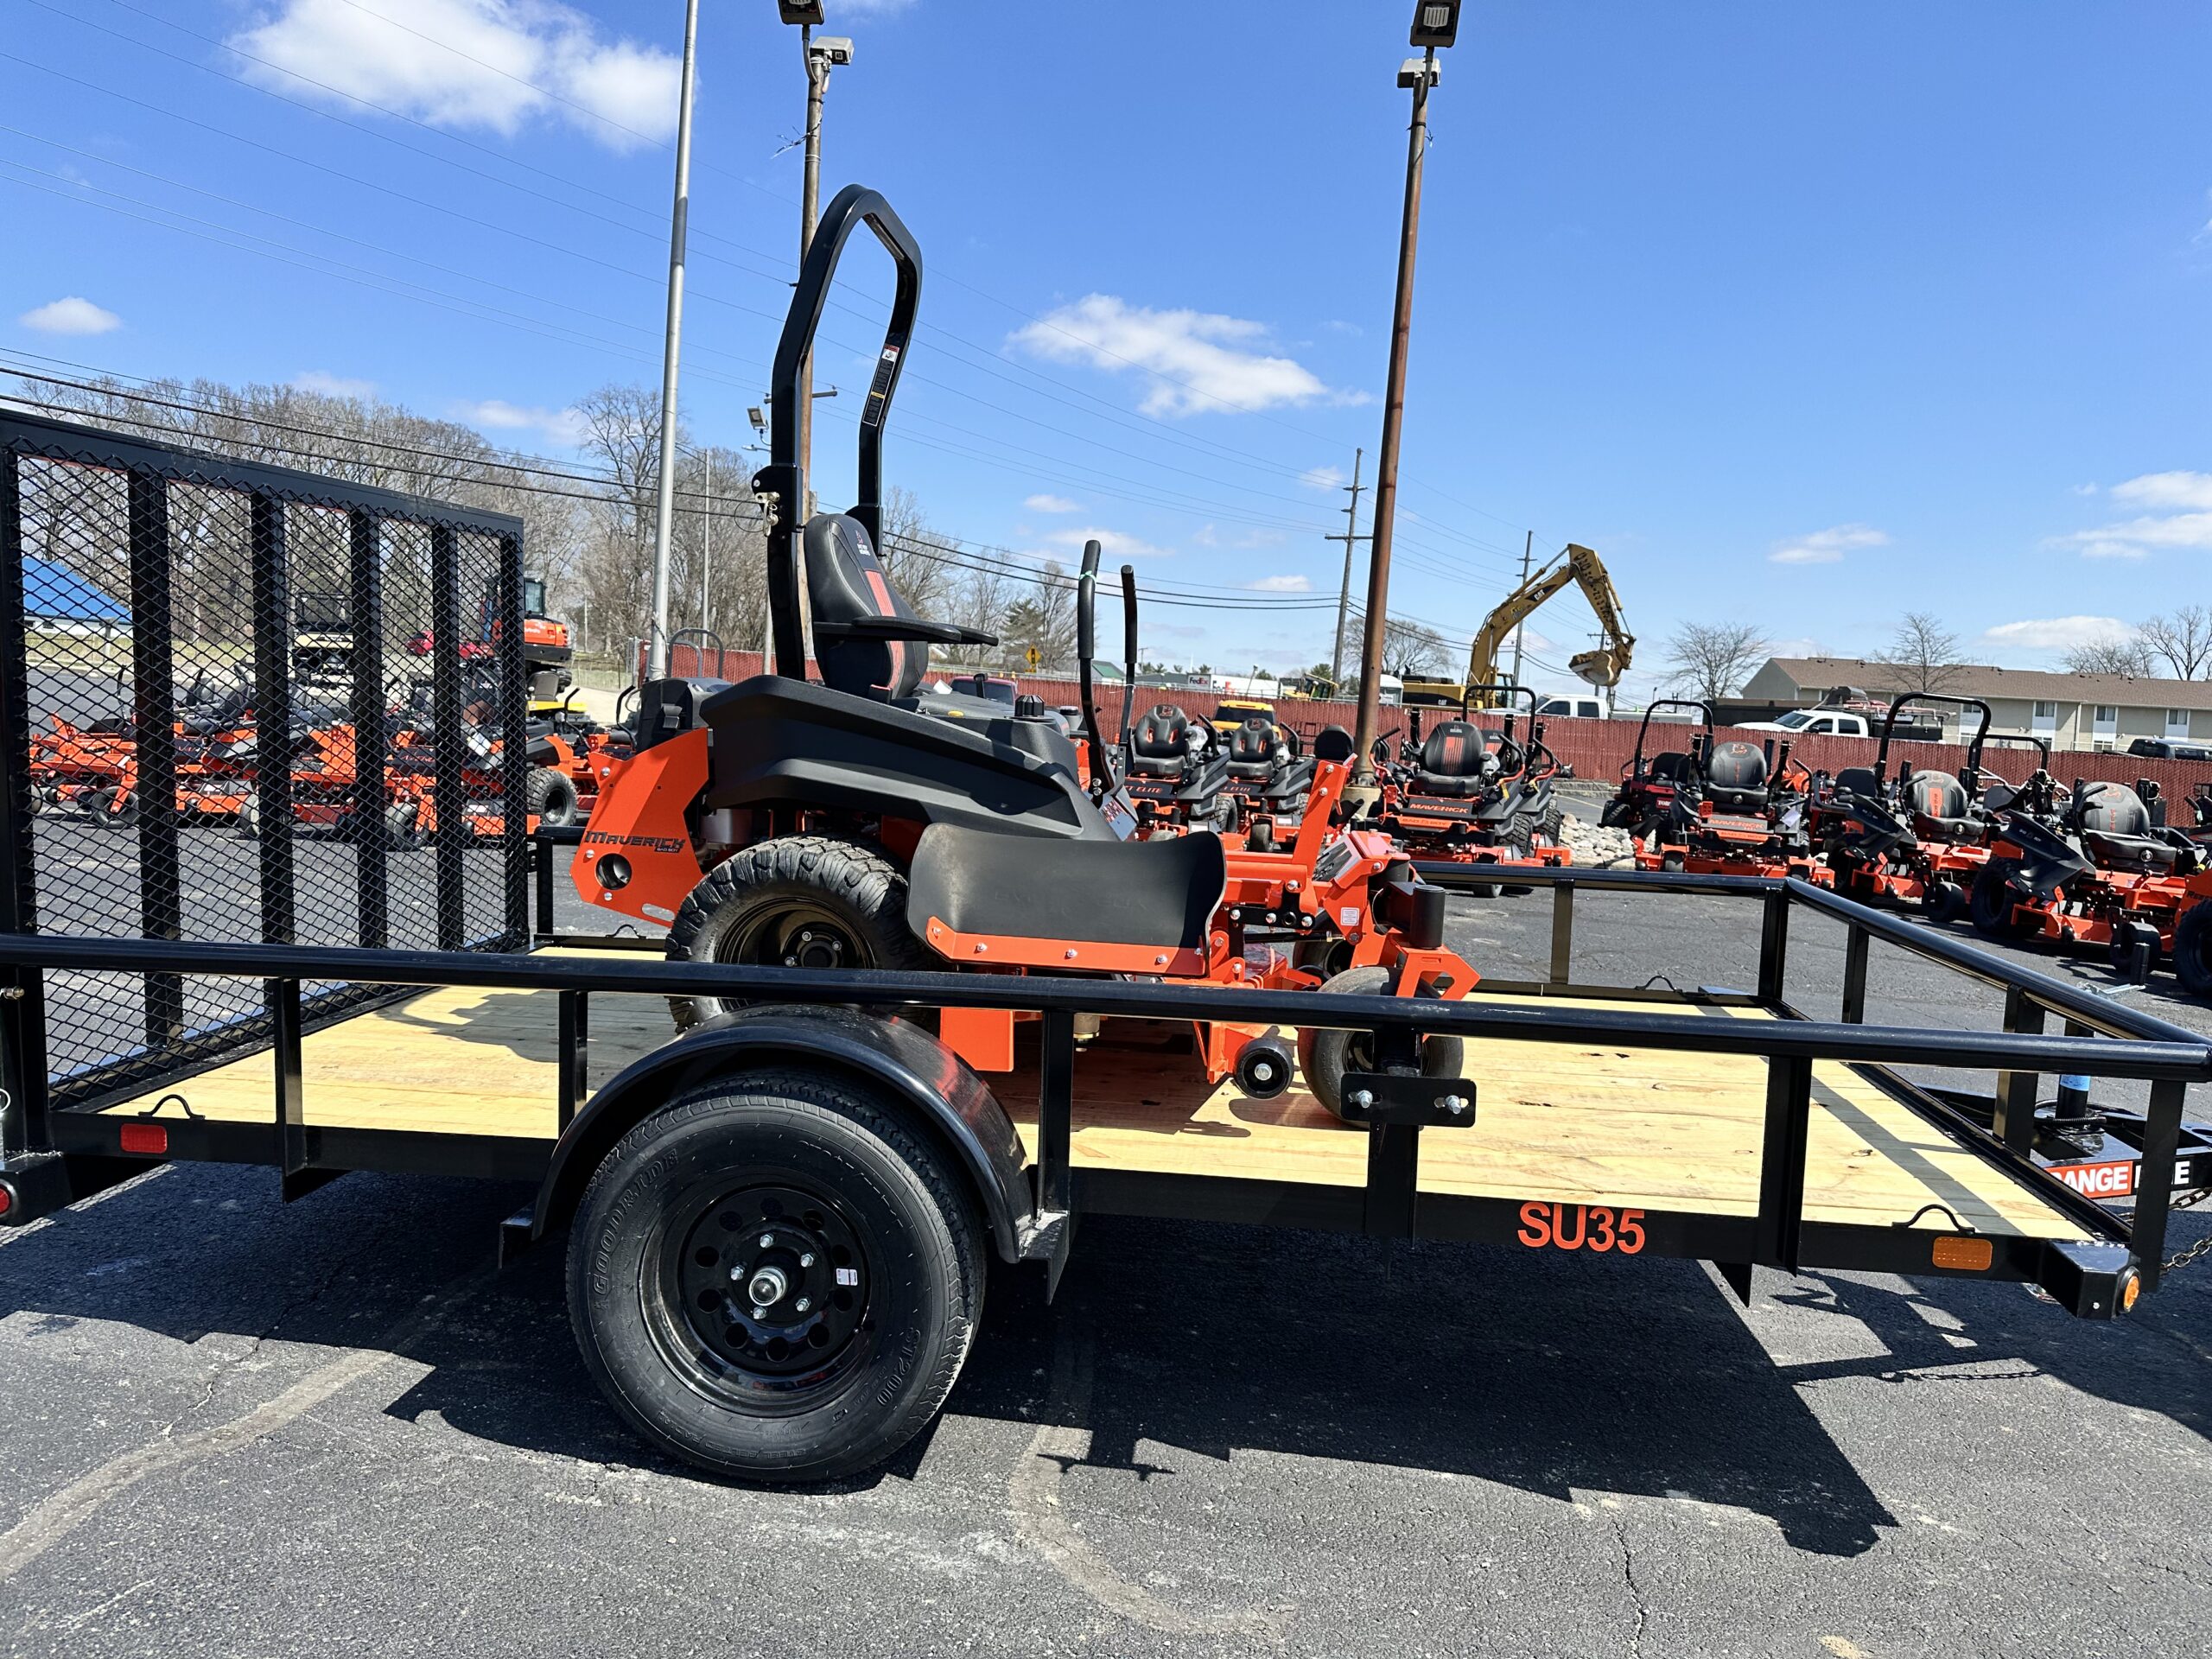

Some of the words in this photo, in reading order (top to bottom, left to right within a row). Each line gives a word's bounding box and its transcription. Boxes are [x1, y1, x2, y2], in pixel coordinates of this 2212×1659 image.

[1534, 589, 1545, 601] CAT
[1409, 804, 1468, 813] MAVERICK
[584, 830, 685, 849] MAVERICK
[593, 1148, 678, 1294] GOODRIDE
[1517, 1202, 1645, 1254] SU35
